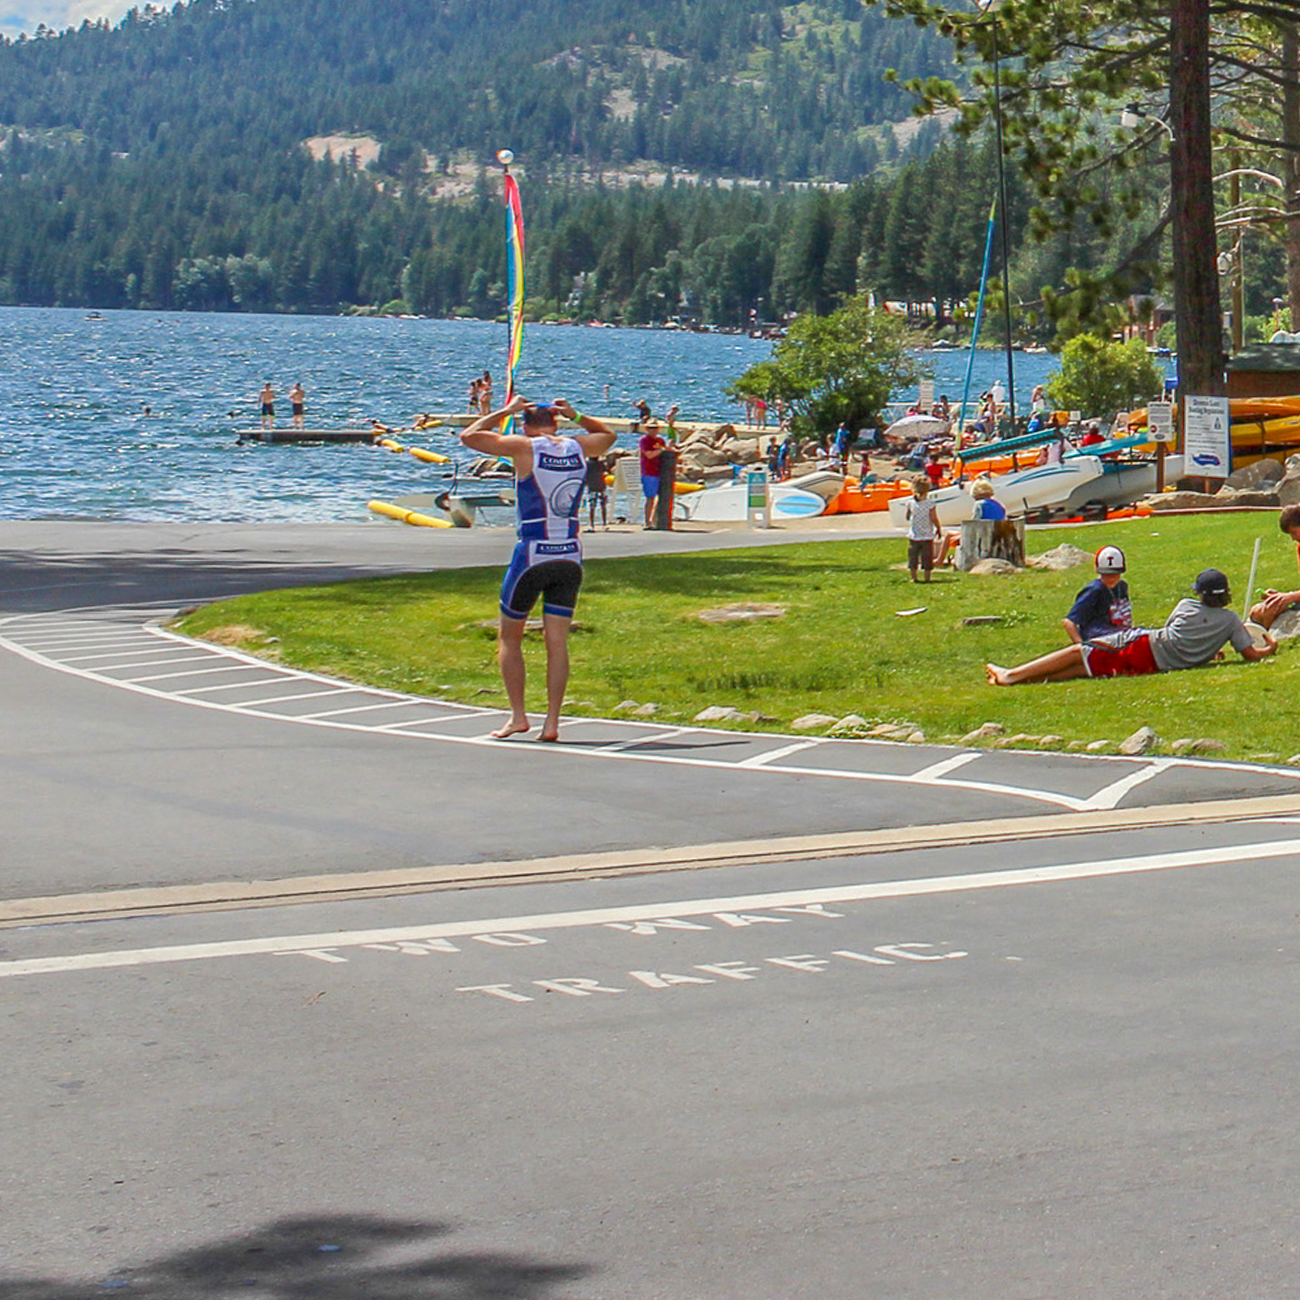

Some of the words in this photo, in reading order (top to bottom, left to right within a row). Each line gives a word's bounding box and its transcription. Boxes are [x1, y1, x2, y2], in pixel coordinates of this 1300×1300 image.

[1107, 556, 1114, 566] T
[273, 931, 549, 963] TWO
[603, 903, 845, 935] WAY
[455, 941, 969, 1002] TRAFFIC
